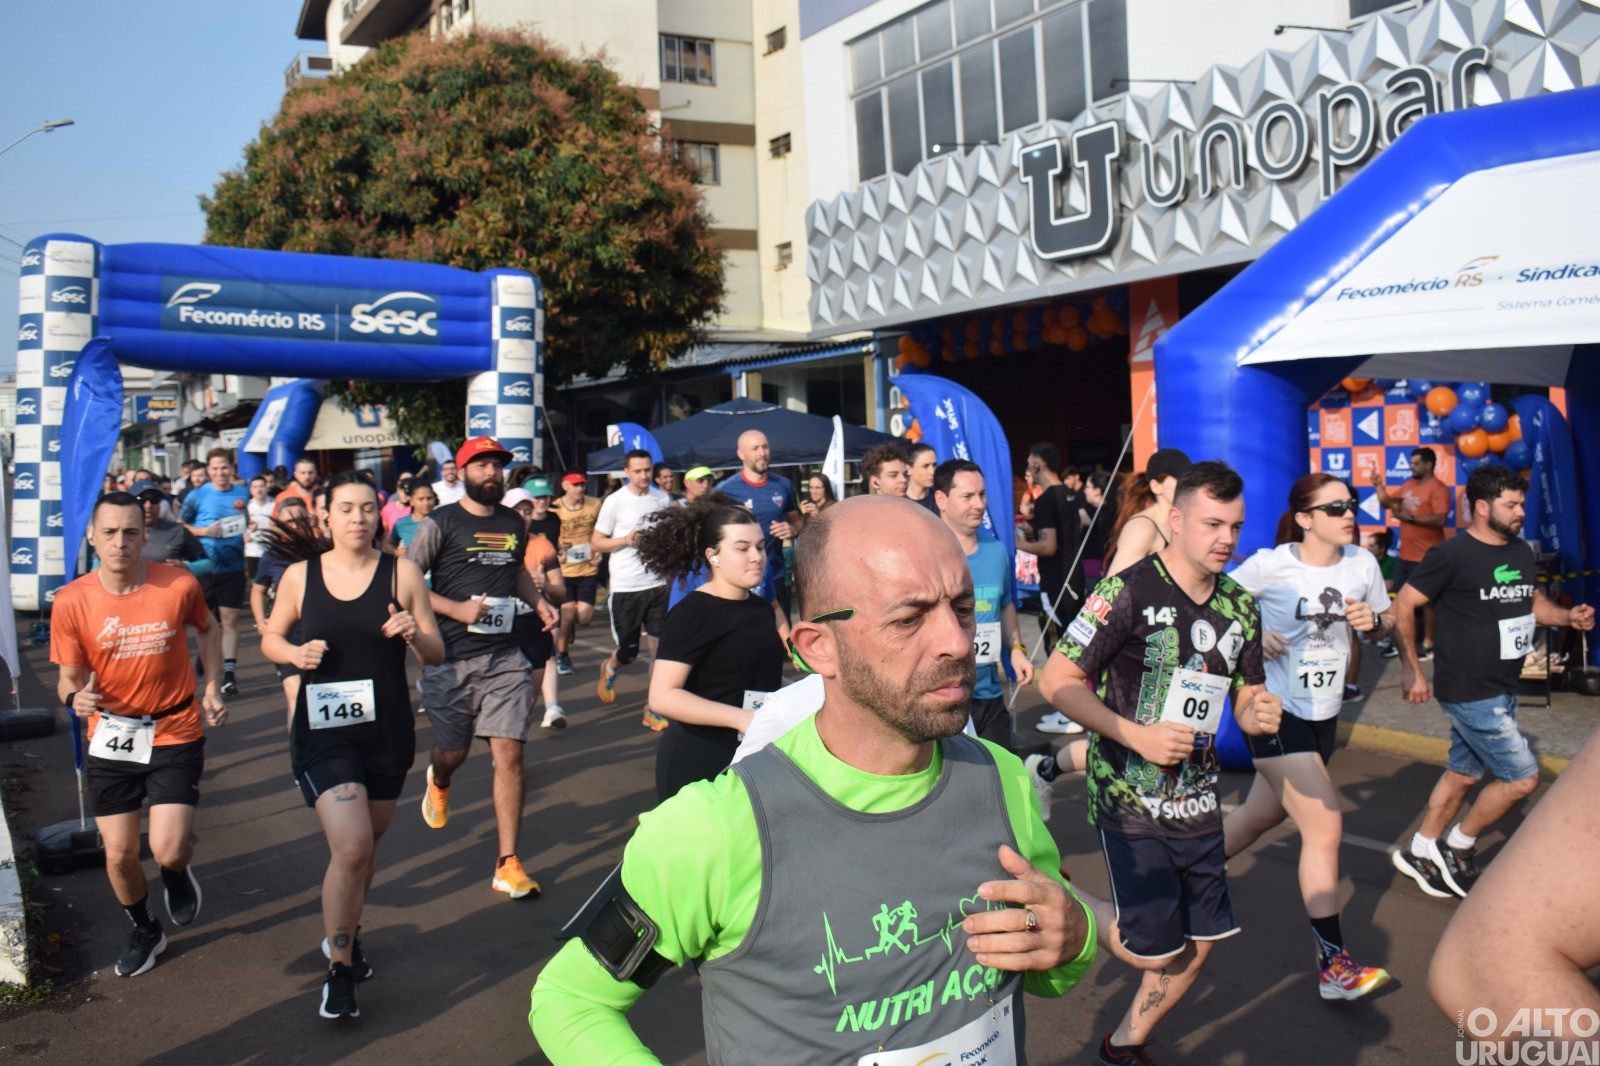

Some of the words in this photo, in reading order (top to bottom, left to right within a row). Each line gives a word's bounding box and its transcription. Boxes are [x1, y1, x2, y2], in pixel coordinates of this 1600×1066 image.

[1141, 45, 1491, 208] unopar
[1337, 276, 1449, 301] Fecomércio
[1454, 271, 1484, 289] RS
[1496, 299, 1552, 312] Sistema
[180, 305, 294, 330] Fecomércio
[297, 312, 326, 331] RS
[49, 364, 73, 378] Se
[342, 433, 397, 447] unopa
[117, 620, 169, 637] RÚSTICA
[1299, 670, 1338, 689] 137
[318, 702, 364, 721] 148
[752, 700, 764, 710] Se
[1183, 697, 1210, 721] 09
[105, 736, 134, 754] 44
[1161, 793, 1219, 820] SICOOB
[835, 980, 935, 1033] NUTRI
[960, 1030, 1000, 1062] Fecomércio
